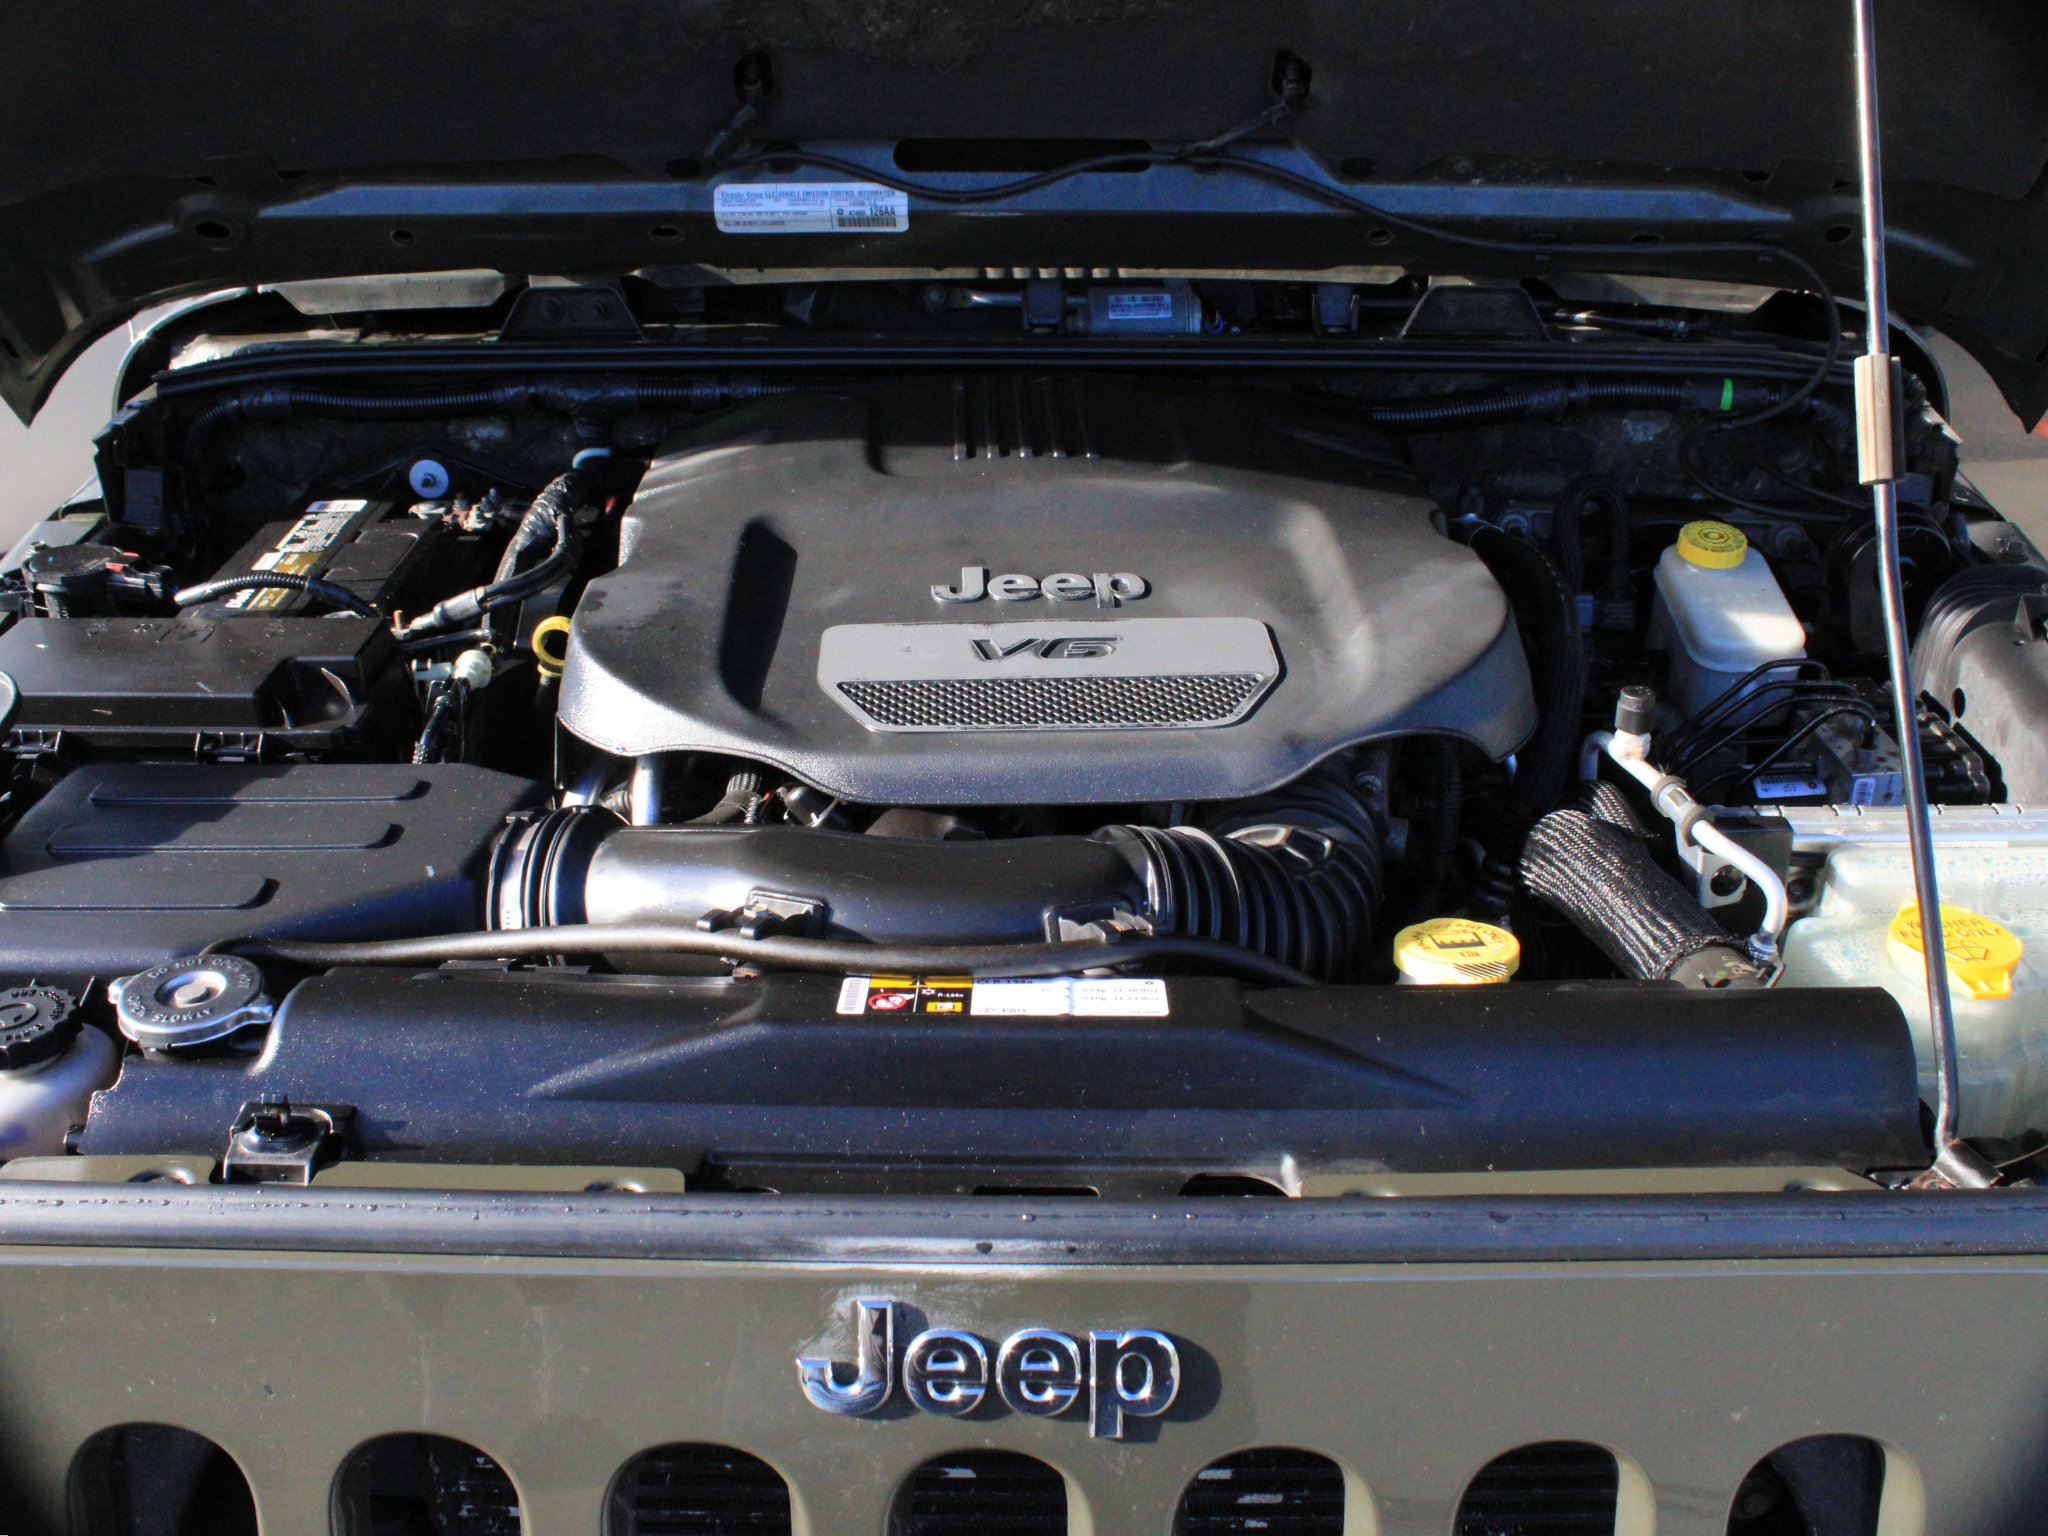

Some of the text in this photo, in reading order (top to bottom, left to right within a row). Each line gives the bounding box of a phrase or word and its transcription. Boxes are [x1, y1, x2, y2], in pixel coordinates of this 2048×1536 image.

[746, 191, 764, 199] Group
[765, 190, 776, 198] LLC
[778, 190, 800, 198] VEHICLE
[857, 189, 896, 197] INFORMATION
[870, 204, 896, 217] 126AA
[931, 566, 1150, 609] Jeep
[969, 635, 1121, 663] V6
[1899, 927, 2002, 939] FLD ONLY
[1903, 918, 1985, 930] WSHER
[146, 966, 169, 979] DO
[174, 957, 205, 969] NOT
[212, 957, 244, 973] OPEN
[127, 994, 212, 1023] OPEN SLOWLY
[795, 1299, 1181, 1440] Jeep
